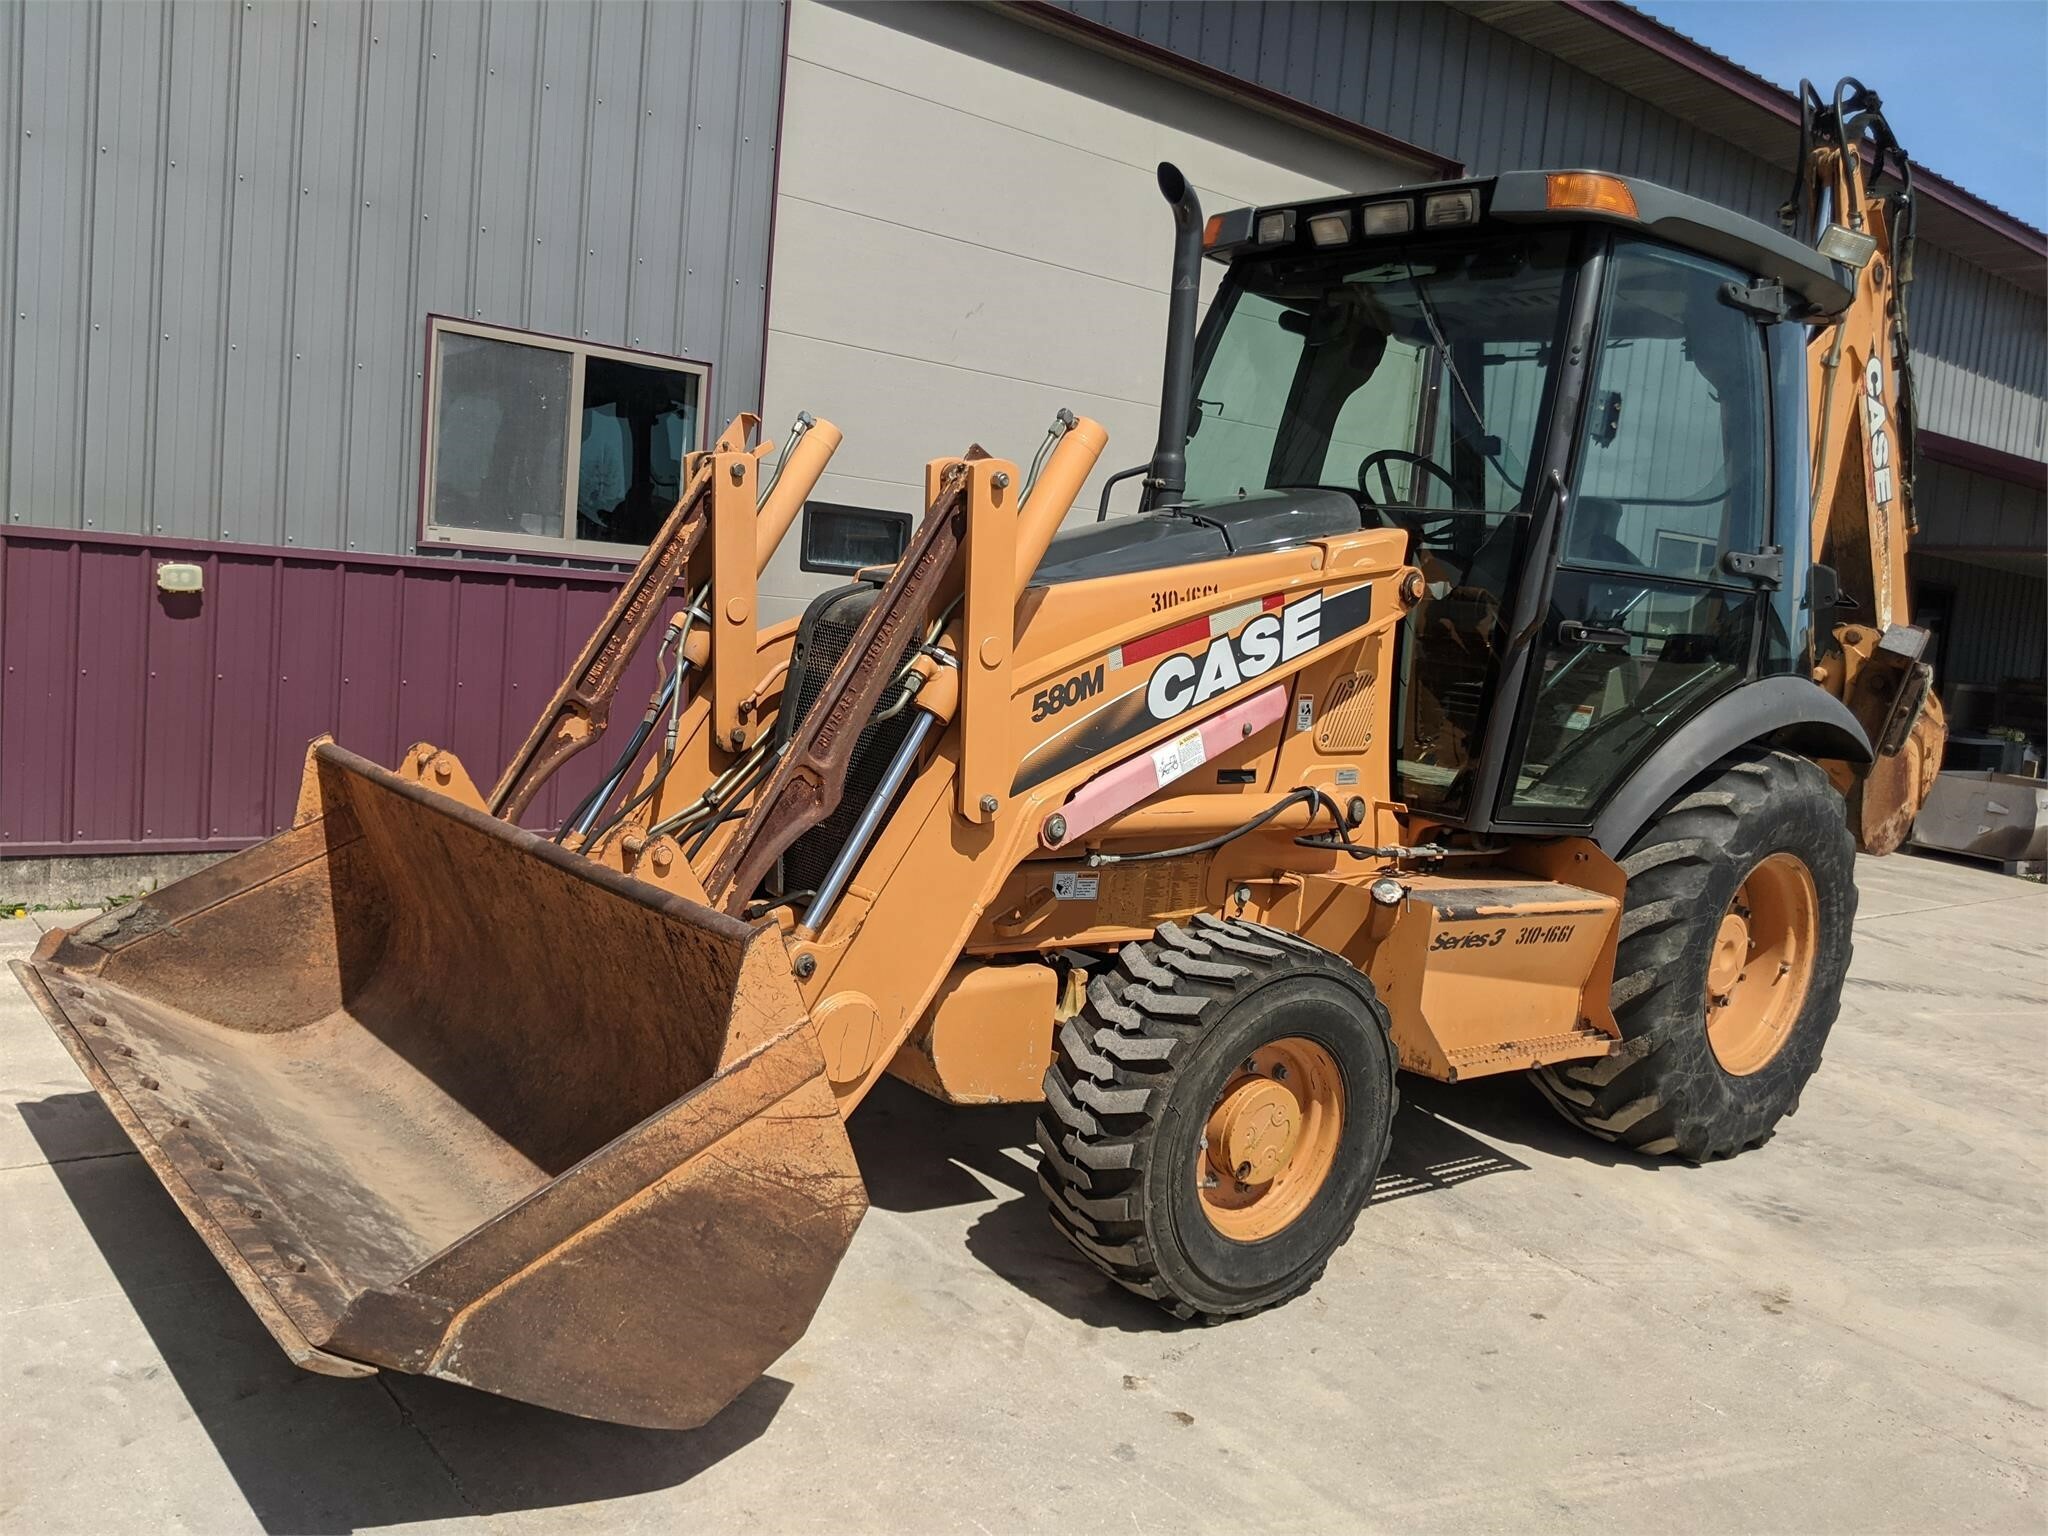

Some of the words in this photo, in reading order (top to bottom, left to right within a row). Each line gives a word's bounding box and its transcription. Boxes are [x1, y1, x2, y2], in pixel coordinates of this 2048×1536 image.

[1865, 357, 1893, 504] CASE
[1031, 664, 1104, 722] 580M
[1147, 590, 1322, 721] CASE
[1515, 924, 1575, 945] 310-1661
